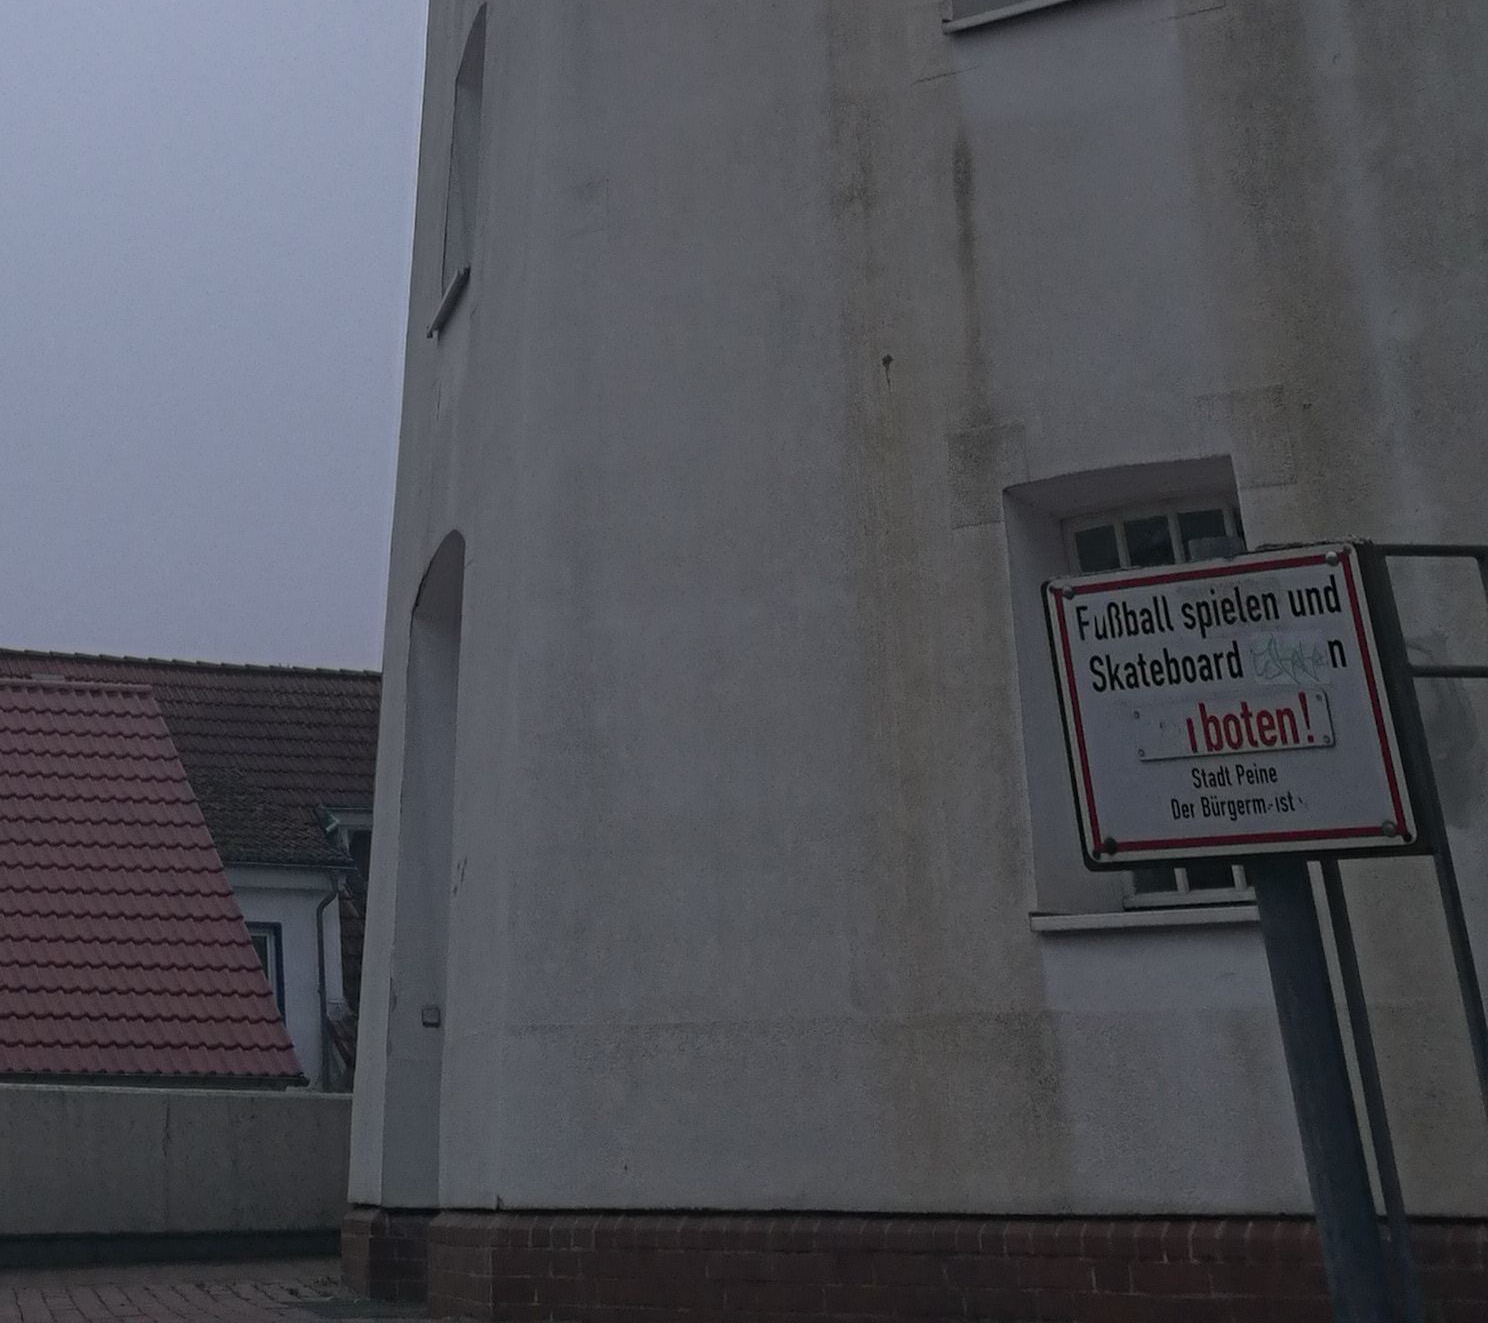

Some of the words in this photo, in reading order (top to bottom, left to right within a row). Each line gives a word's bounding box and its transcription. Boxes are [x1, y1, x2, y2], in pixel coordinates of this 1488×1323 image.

[1075, 594, 1174, 641] Fußball
[1180, 586, 1280, 638] spielen
[1288, 574, 1342, 618] und
[1089, 640, 1243, 693] Skateboard
[1191, 765, 1232, 789] Stadt
[1235, 763, 1278, 786] Peine
[1170, 798, 1196, 820] Der
